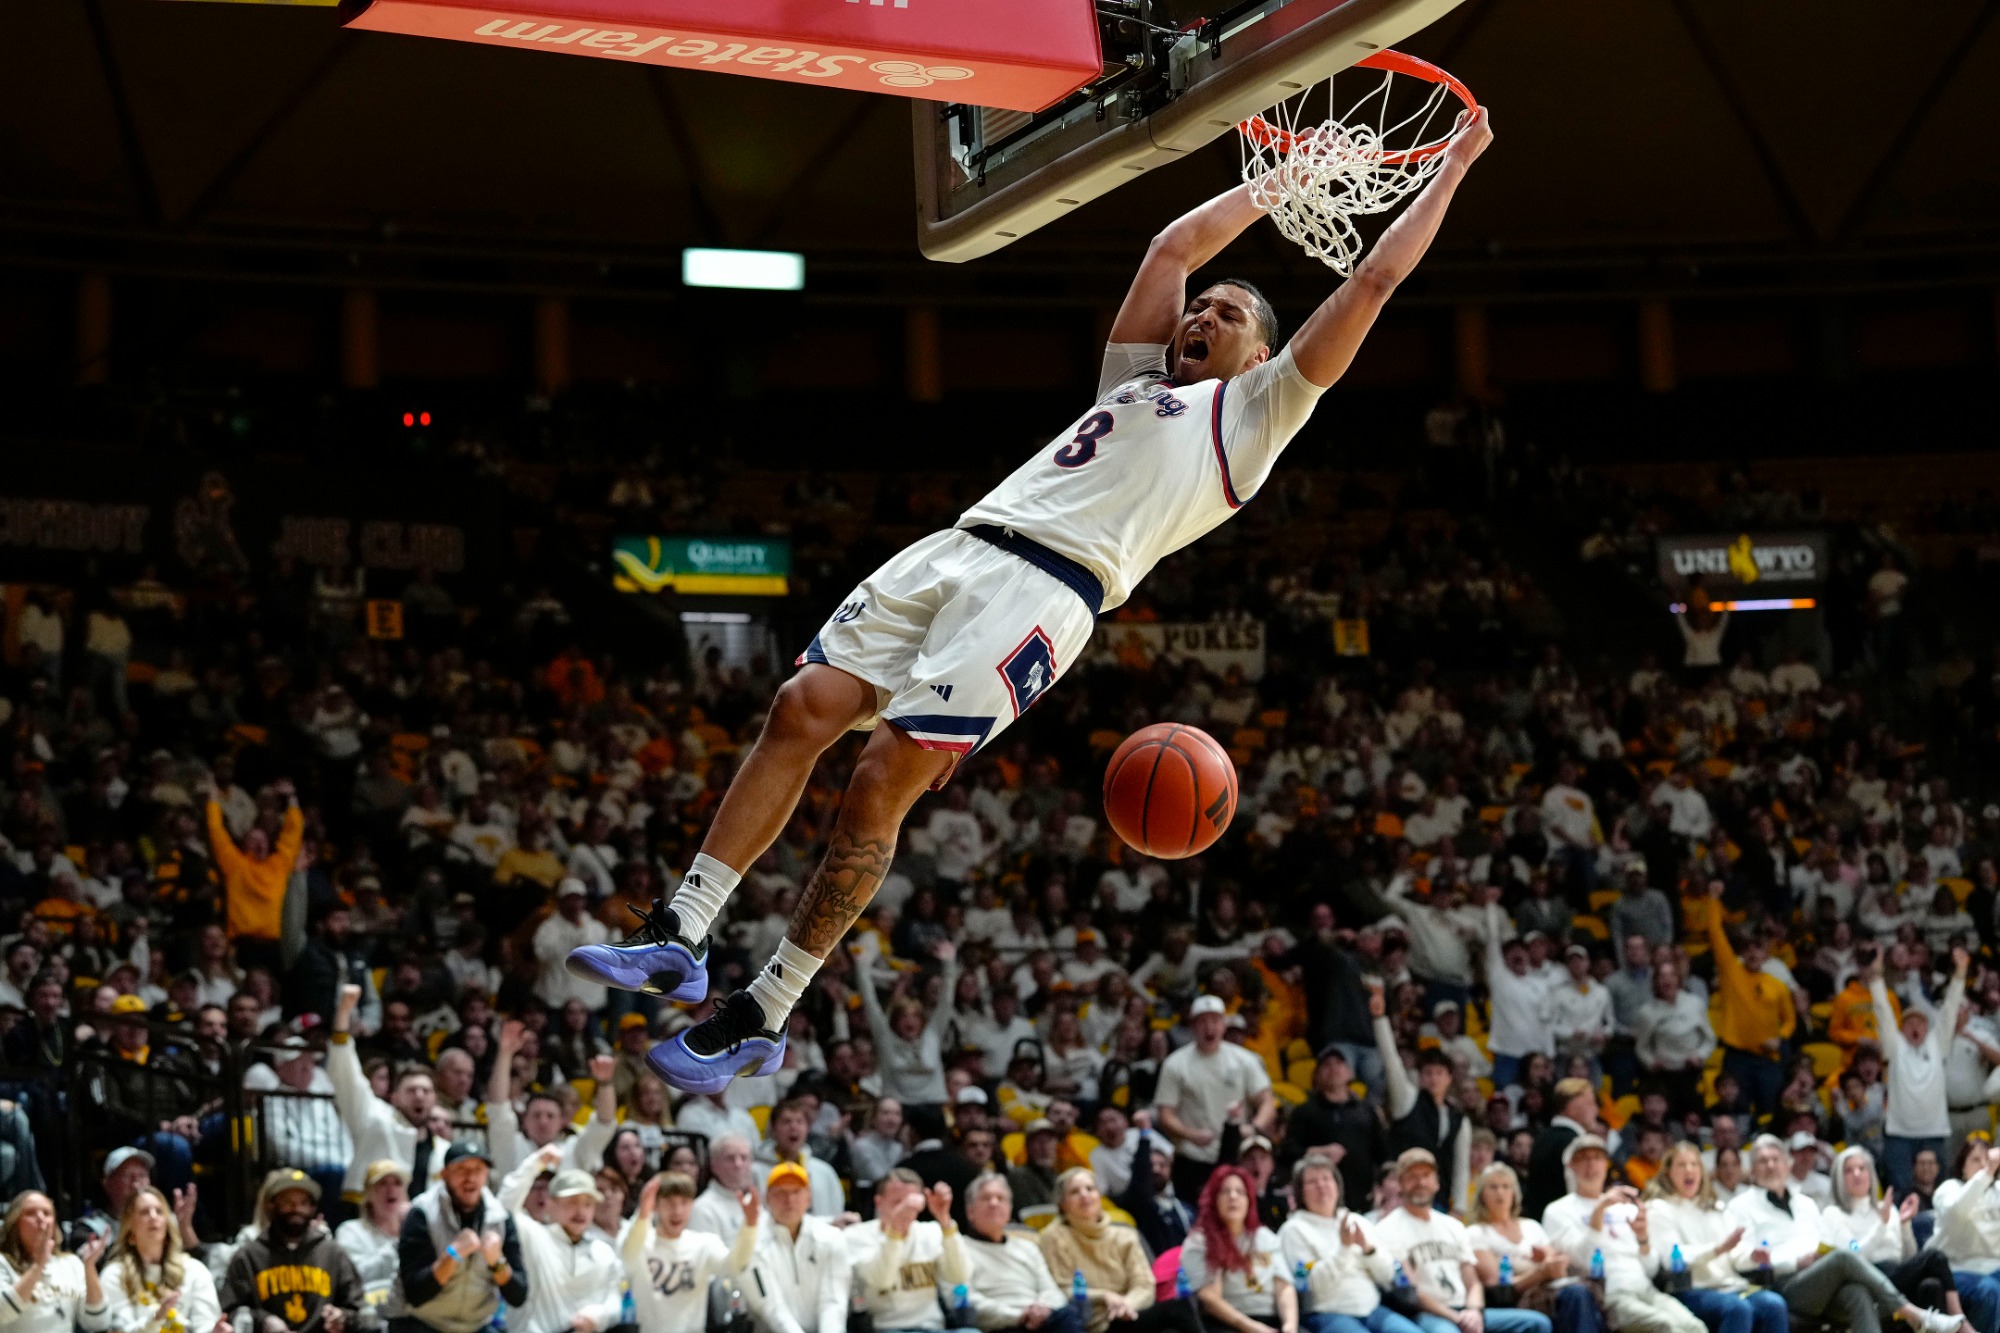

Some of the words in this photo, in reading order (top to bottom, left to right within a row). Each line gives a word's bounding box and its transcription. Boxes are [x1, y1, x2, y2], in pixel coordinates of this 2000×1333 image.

[1053, 409, 1116, 469] 3
[687, 540, 765, 569] QUALITY
[1672, 548, 1729, 576] UNI
[1753, 545, 1816, 570] WYO
[1163, 626, 1260, 652] POKES
